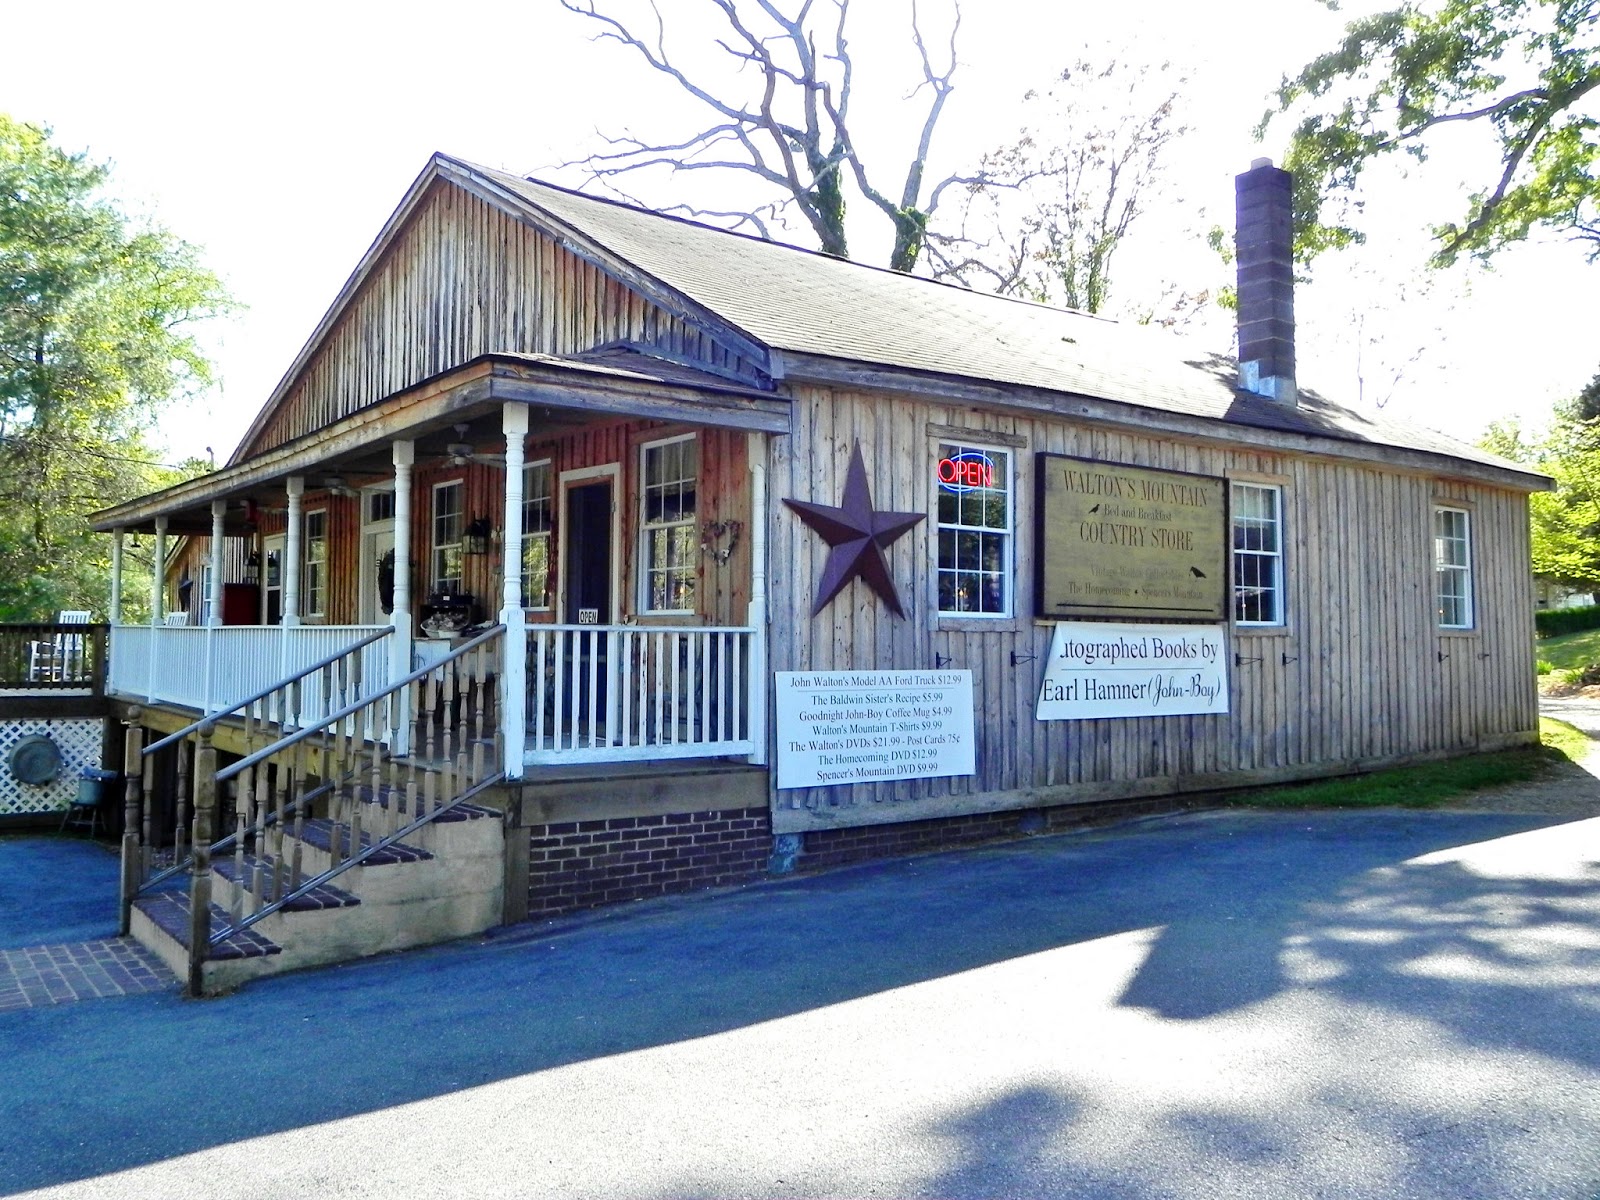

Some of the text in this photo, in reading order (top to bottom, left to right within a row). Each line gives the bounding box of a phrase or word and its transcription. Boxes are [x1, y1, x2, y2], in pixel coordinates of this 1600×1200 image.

[938, 458, 992, 487] OPEN
[1064, 470, 1208, 507] WALTON'S MOUNTAIN
[1104, 504, 1172, 522] Bed and Breakfast
[1080, 520, 1193, 551] COUNTRY STORE
[1068, 581, 1082, 594] The
[1085, 582, 1131, 597] Homecoming
[580, 611, 596, 622] OPEN
[1060, 636, 1218, 664] utographed Books by
[790, 674, 962, 688] John Walton's Model AA Ford Truck $12.99
[1042, 678, 1078, 702] Earl
[1084, 678, 1146, 700] Hamner
[812, 692, 943, 705] The Baldwin Sister's Recipe $5.99
[800, 706, 952, 722] Goodnight John-Boy Coffee Mug $4.99
[812, 720, 942, 736] Walton's Mountain T-Shirts $9.99
[789, 742, 806, 752] The
[808, 740, 844, 751] Walton's
[846, 738, 870, 749] DVDs
[872, 736, 900, 748] $21.99
[907, 735, 922, 746] Post
[924, 734, 946, 744] Cards
[948, 734, 960, 744] 75¢
[818, 748, 938, 766] The Homecoming DVD $12.99
[816, 762, 938, 782] Spencer's Mountain DVD $9.99
